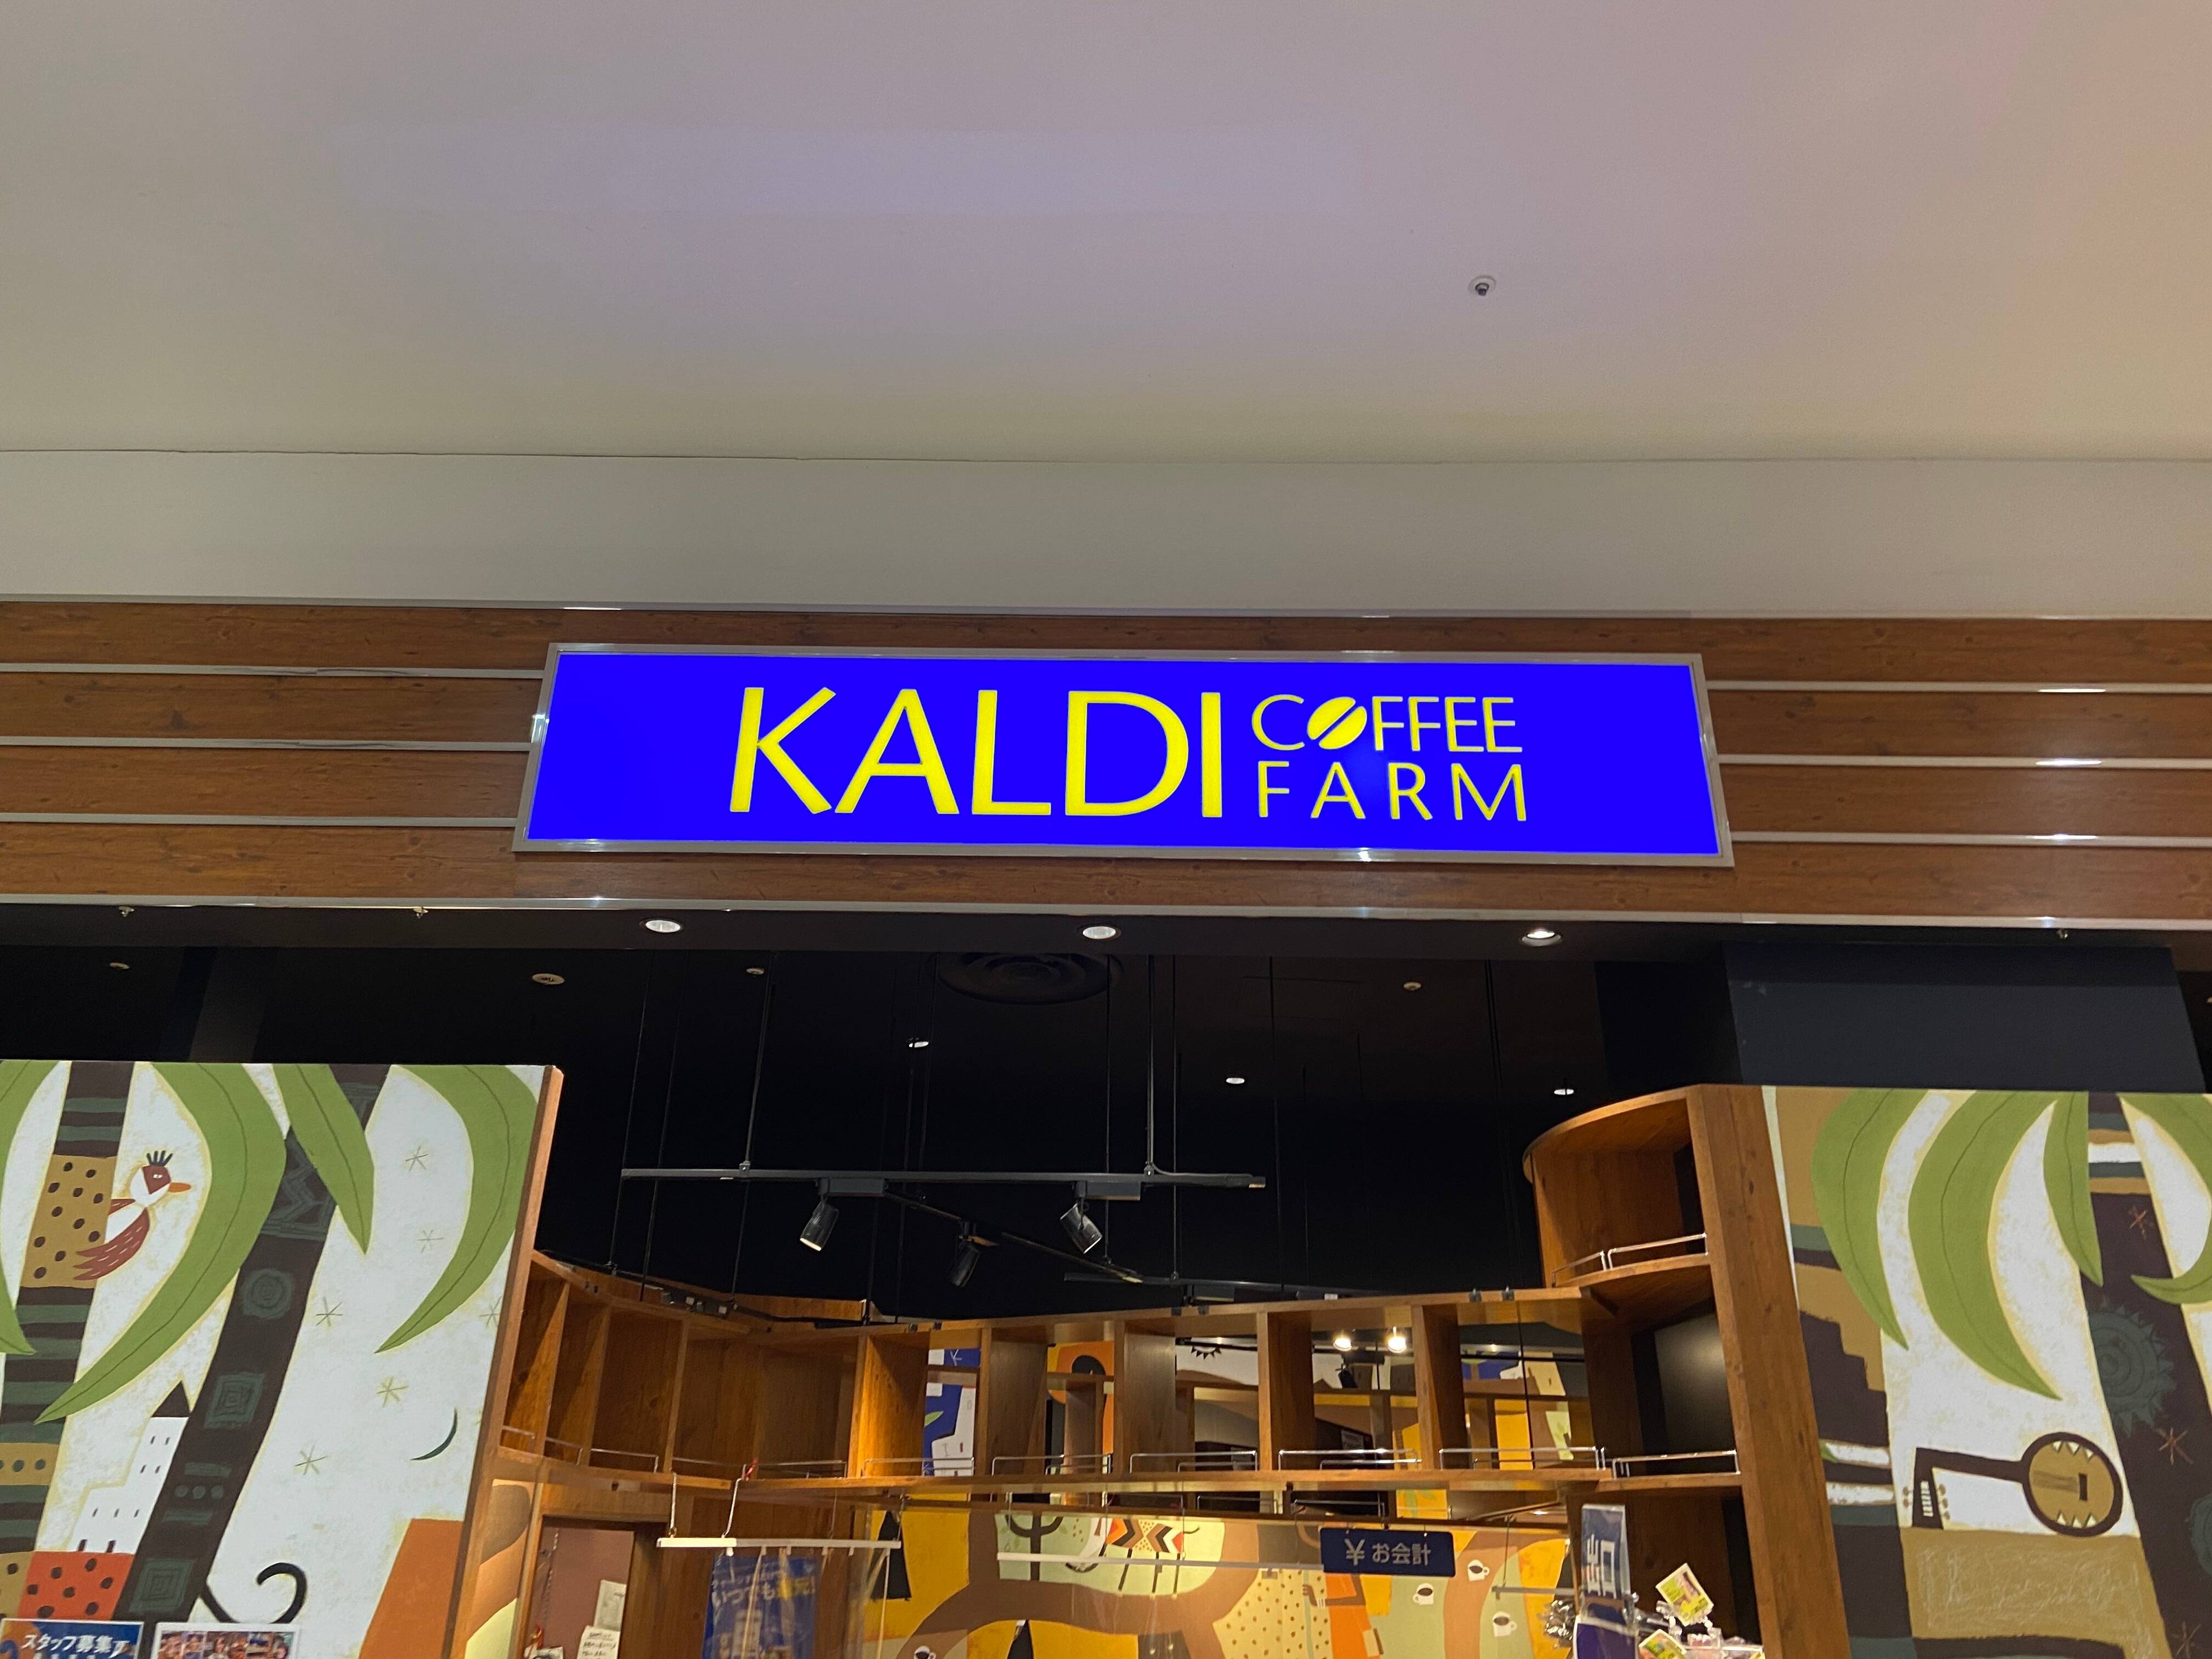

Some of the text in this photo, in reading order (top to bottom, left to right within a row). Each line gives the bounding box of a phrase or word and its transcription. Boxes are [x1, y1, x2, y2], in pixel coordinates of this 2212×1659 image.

[730, 687, 1222, 818] KALDI
[1251, 695, 1521, 753] COFFEE
[1258, 761, 1526, 821] FARM
[1372, 1542, 1431, 1566] お会計
